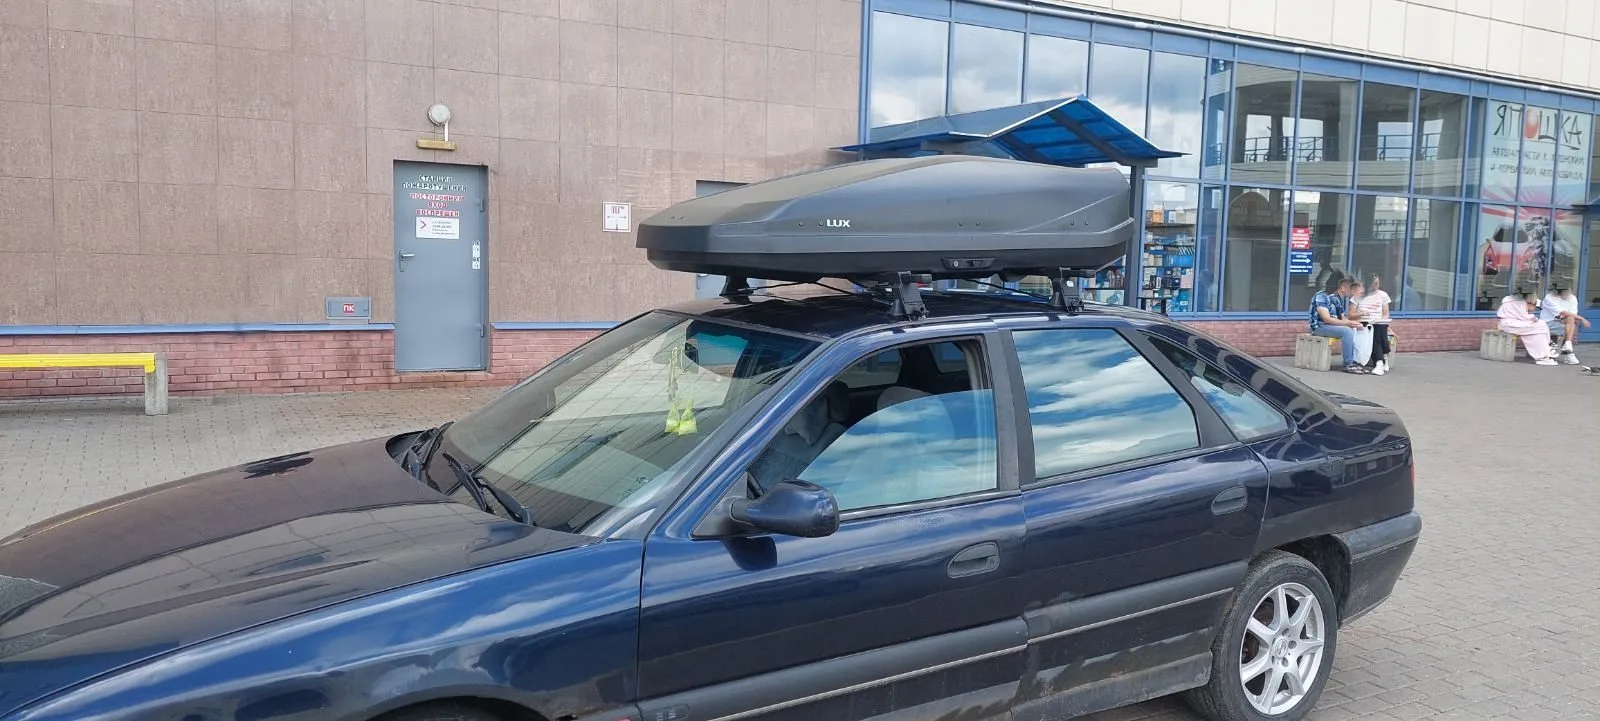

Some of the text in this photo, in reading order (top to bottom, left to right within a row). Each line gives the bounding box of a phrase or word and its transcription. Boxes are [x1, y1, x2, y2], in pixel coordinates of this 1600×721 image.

[428, 201, 448, 209] ВХОД
[826, 218, 851, 228] LUX
[343, 304, 354, 312] ПК
